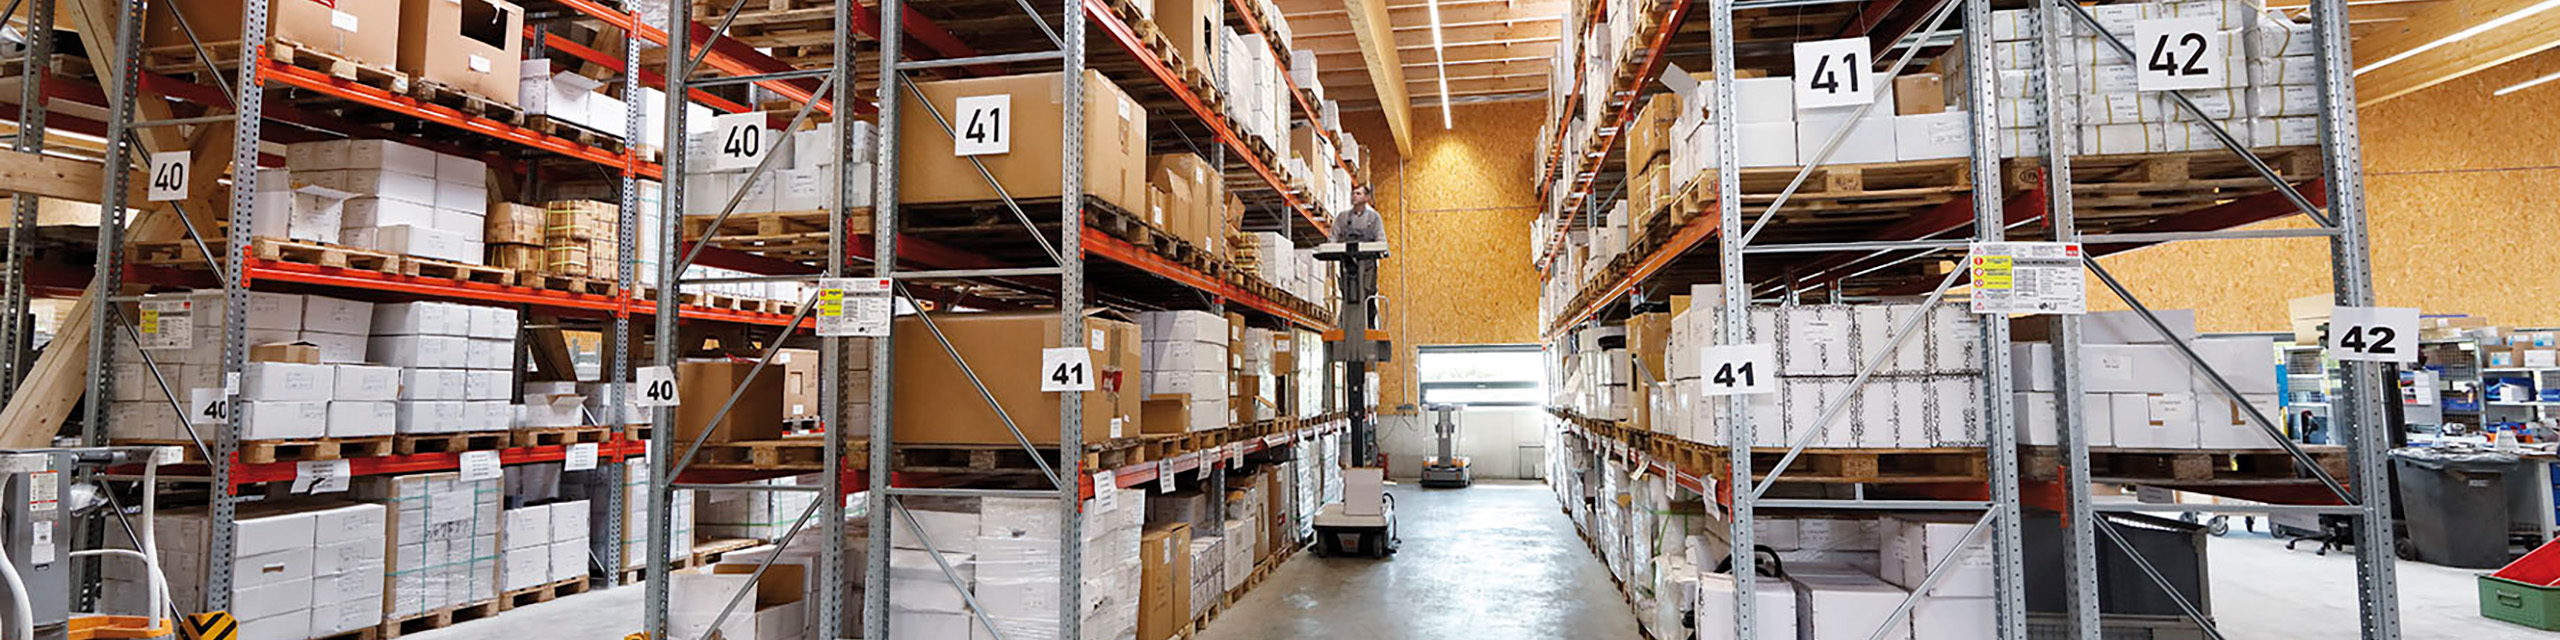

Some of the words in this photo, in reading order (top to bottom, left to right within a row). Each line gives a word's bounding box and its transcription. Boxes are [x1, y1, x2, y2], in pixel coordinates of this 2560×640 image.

[2149, 33, 2208, 76] 42
[1811, 53, 1858, 93] 41
[966, 108, 999, 143] 41
[724, 125, 758, 157] 40
[155, 162, 183, 191] 40
[2341, 326, 2395, 353] 42
[1052, 362, 1083, 385] 41
[1714, 362, 1754, 387] 41
[647, 380, 673, 400] 40
